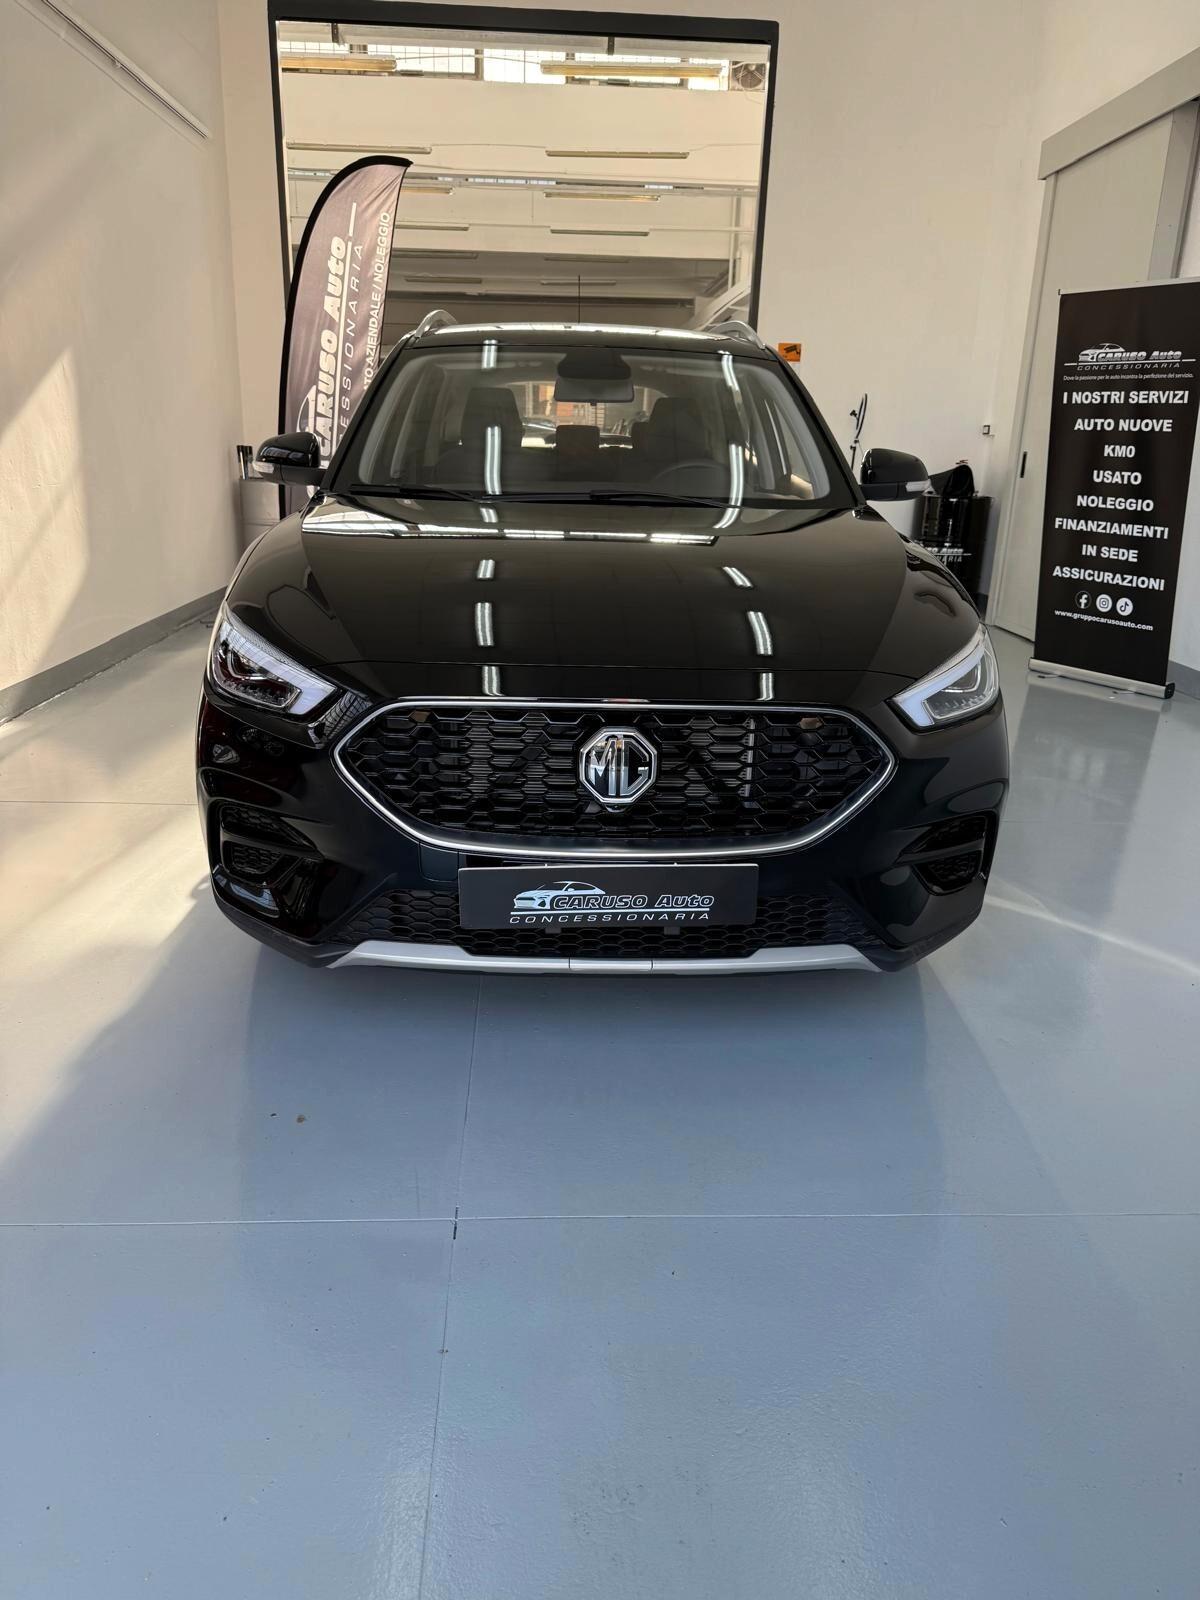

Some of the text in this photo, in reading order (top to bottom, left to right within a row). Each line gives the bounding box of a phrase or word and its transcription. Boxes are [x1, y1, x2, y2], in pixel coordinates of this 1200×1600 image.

[364, 292, 382, 366] AZIENDALE
[373, 212, 391, 283] NOLEGGIO
[315, 236, 346, 457] CARUSO Auto
[338, 244, 364, 438] ESSIONARIA
[1097, 350, 1183, 362] CARUSO Auto
[1077, 362, 1180, 371] CONCESSIONARIA
[1063, 390, 1190, 404] I NOSTRI SERVIZI
[1074, 418, 1173, 432] AUTO NUOVE
[1093, 470, 1142, 485] USATO
[1076, 495, 1154, 512] NOLEGGIO
[1054, 517, 1169, 539] FINANZIAMENTI
[1081, 544, 1139, 562] IN SEDE
[1052, 565, 1165, 591] ASSICURAZIONI
[1054, 609, 1153, 631] www.gruppocarusoauto.com
[589, 737, 649, 796] MG
[553, 894, 715, 909] CARUSO Auto
[509, 912, 709, 924] CONCESSIONARIA
